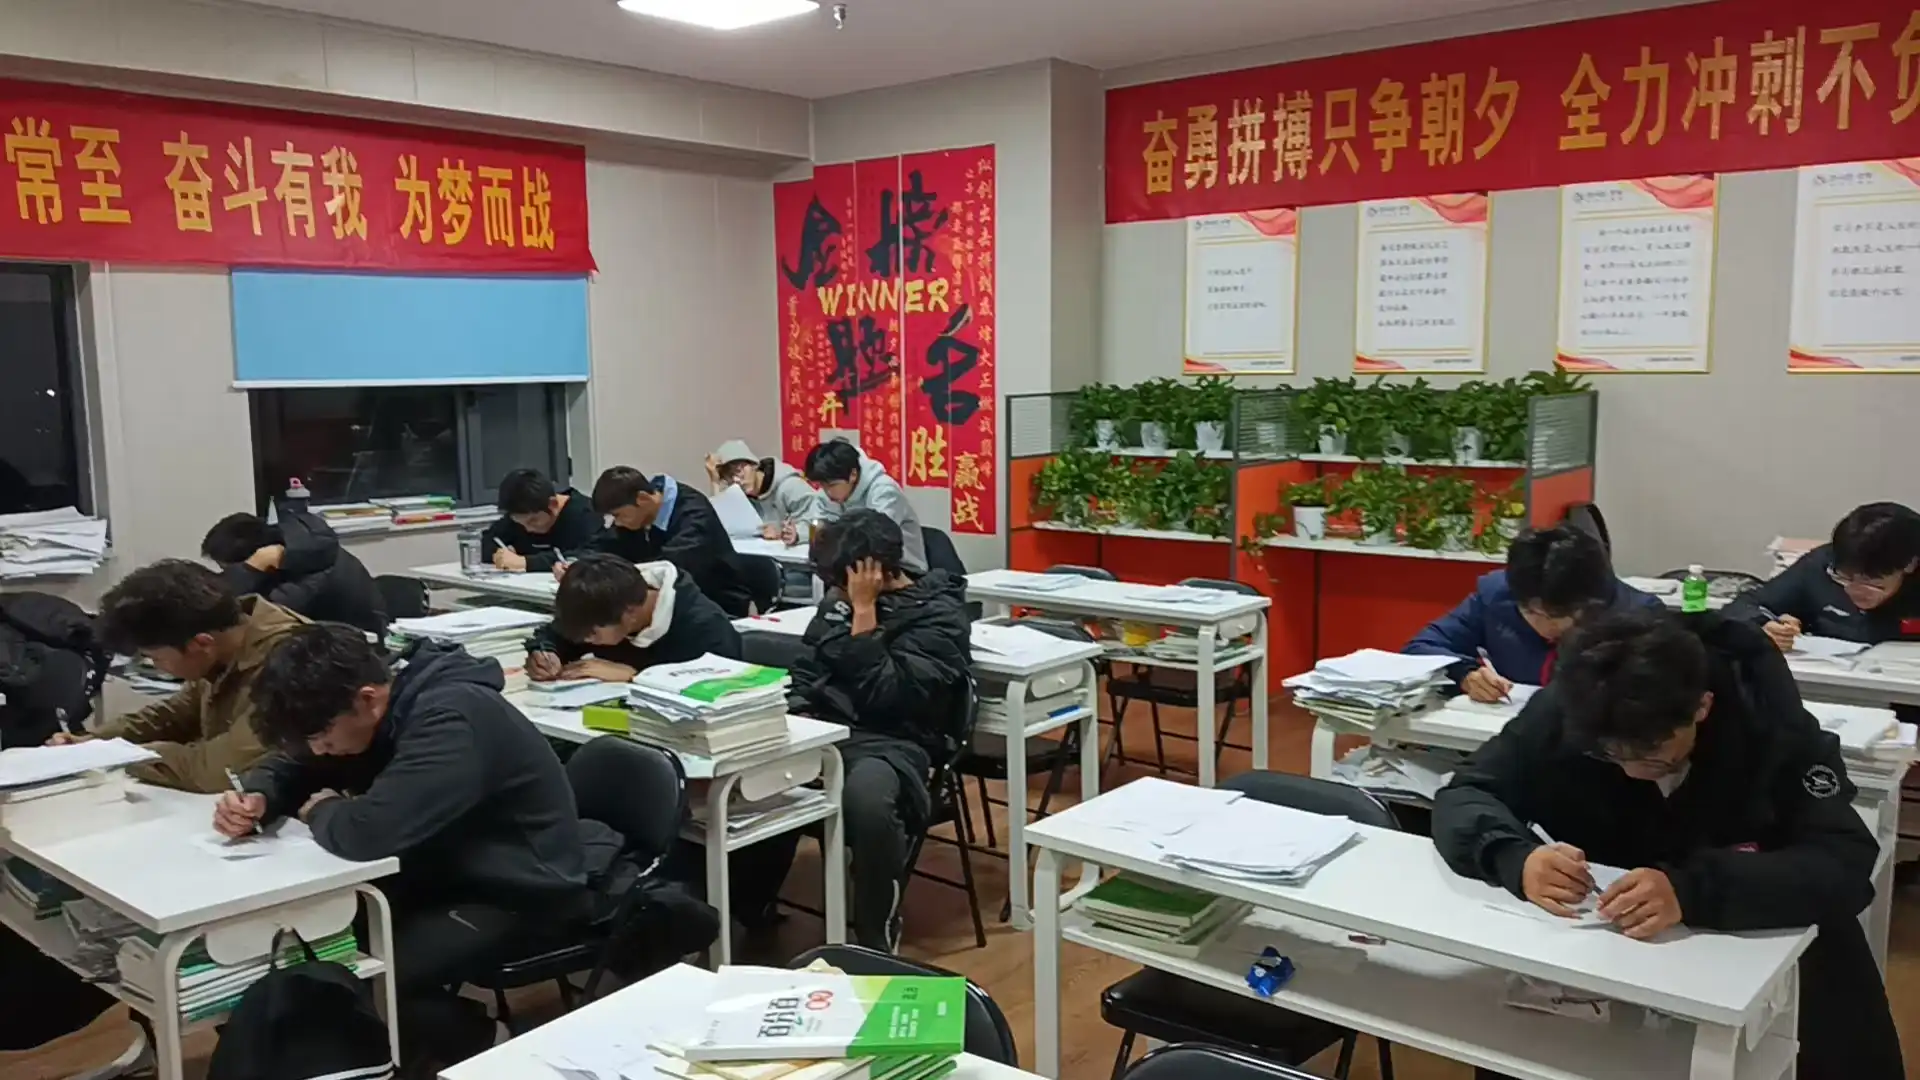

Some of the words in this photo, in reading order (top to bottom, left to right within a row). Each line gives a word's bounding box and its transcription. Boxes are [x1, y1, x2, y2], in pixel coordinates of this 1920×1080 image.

[5, 117, 132, 224] 常至
[163, 130, 368, 240] 奋斗有我
[395, 154, 555, 251] 为梦而战
[1142, 65, 1521, 195] 奋勇拼搏只争朝夕
[817, 277, 950, 317] WINNER
